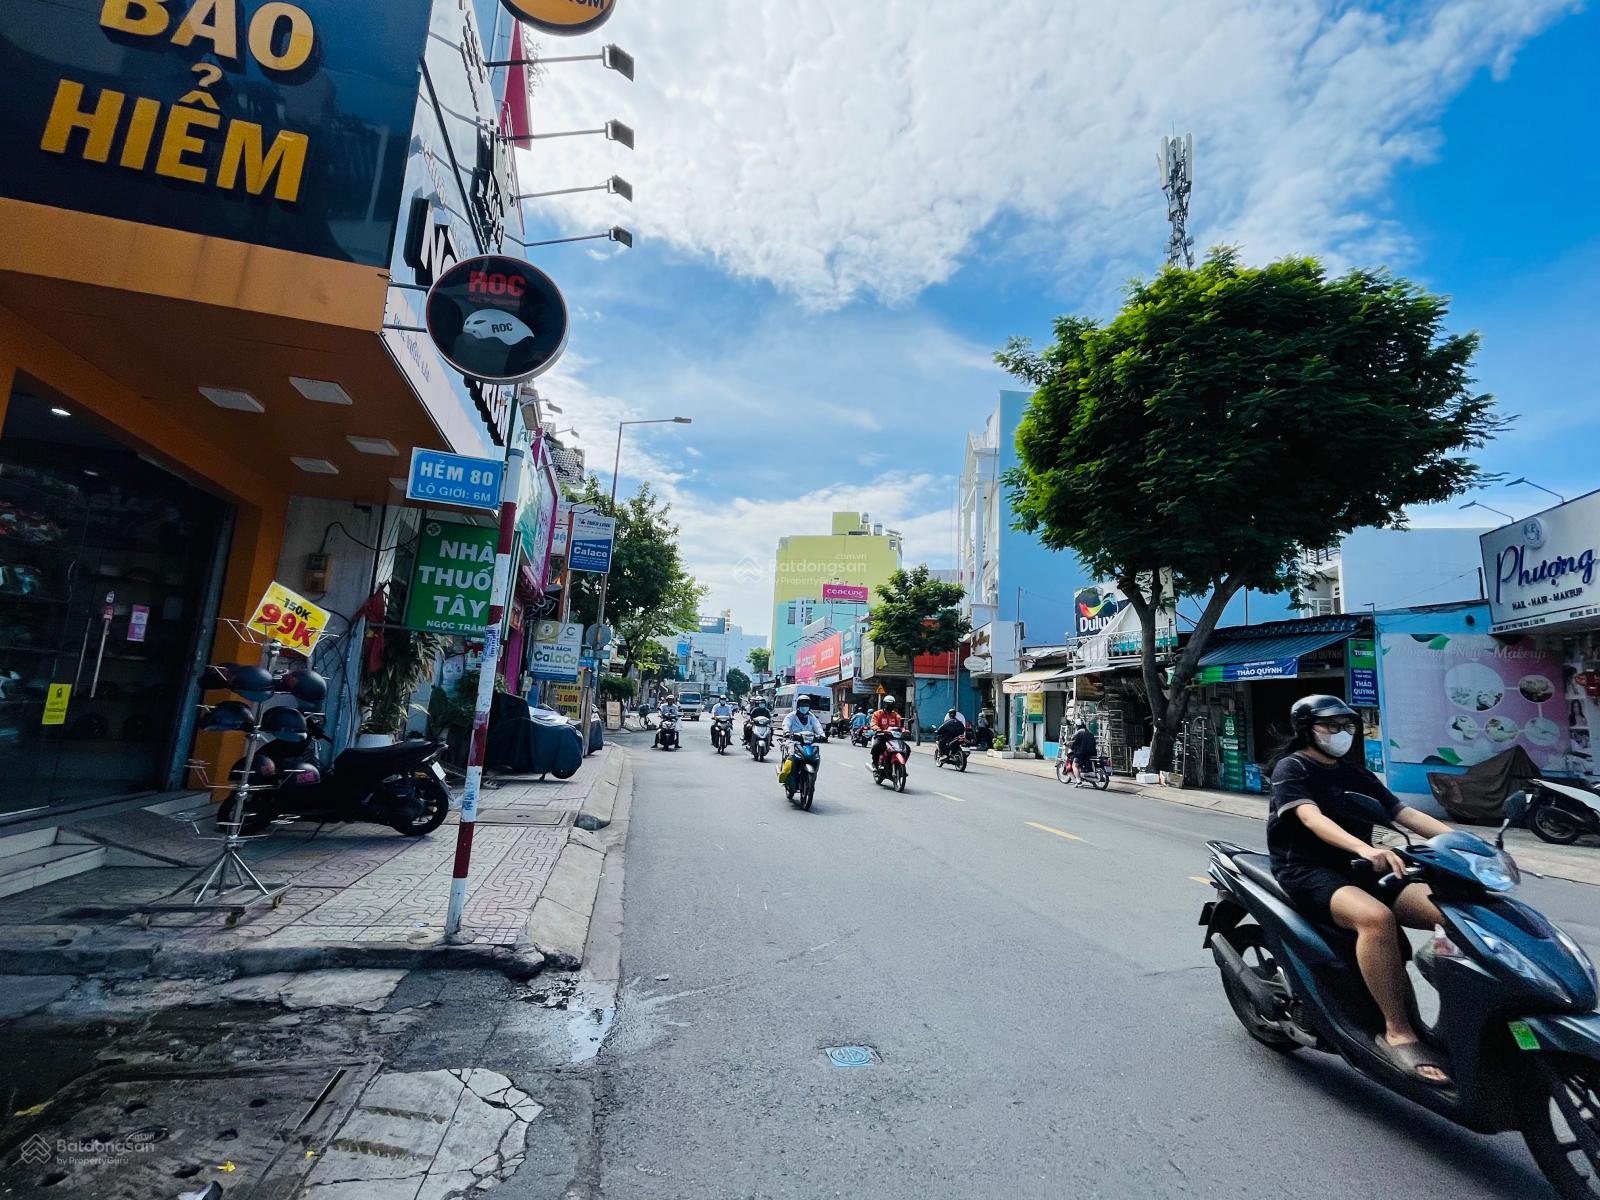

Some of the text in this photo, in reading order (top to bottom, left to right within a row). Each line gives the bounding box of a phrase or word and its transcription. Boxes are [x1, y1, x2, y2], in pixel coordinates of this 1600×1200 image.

[40, 62, 309, 202] HIỂM
[468, 270, 526, 297] ROC
[491, 322, 513, 334] ROC
[420, 458, 494, 487] HẺM 80
[418, 482, 436, 496] LỘ
[473, 491, 491, 502] 6M
[439, 540, 495, 564] NHÀ
[574, 546, 608, 558] Calaco
[418, 565, 494, 591] THUỐ
[1495, 544, 1597, 604] Phượng
[432, 593, 488, 618] TÂY
[1552, 587, 1584, 600] MAKEUP
[283, 597, 312, 622] 150K
[254, 603, 316, 648] 99K
[426, 619, 456, 631] NGỌC
[1079, 615, 1114, 633] Dulux
